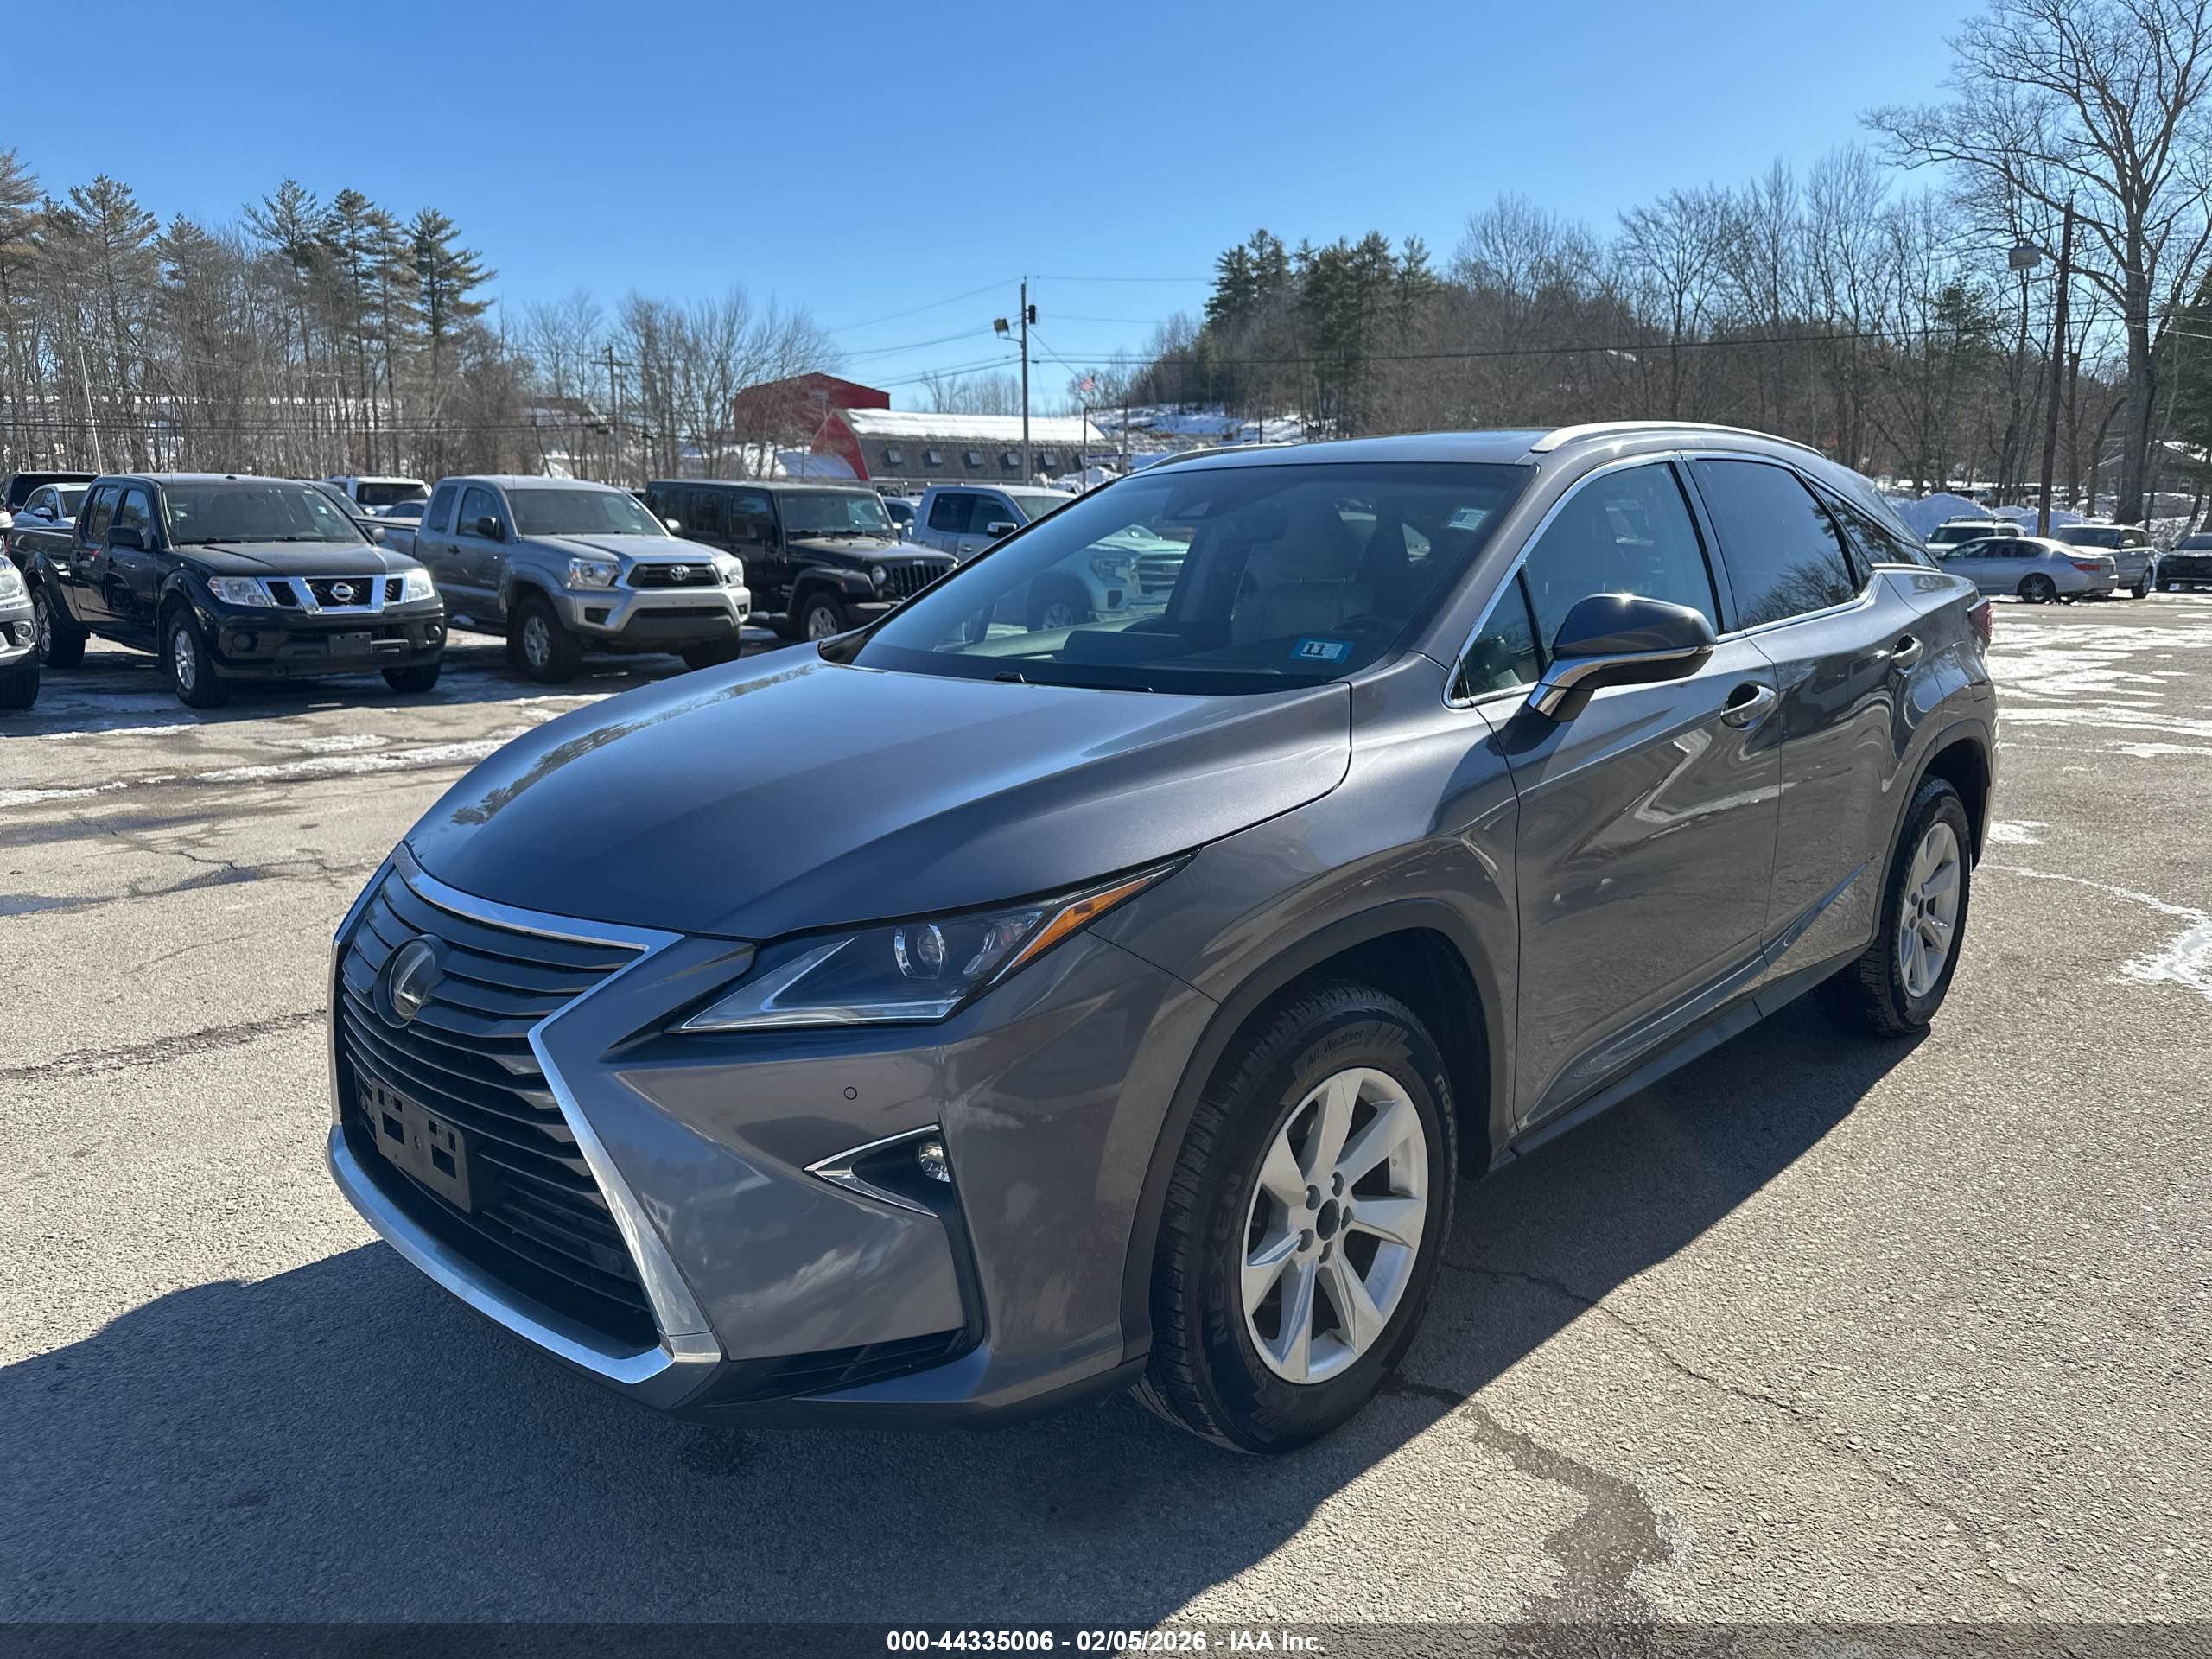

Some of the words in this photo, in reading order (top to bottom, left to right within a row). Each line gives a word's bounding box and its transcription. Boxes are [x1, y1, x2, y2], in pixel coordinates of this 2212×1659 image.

[1301, 643, 1325, 656] 11
[1306, 1028, 1364, 1069] All-Weather
[1209, 1172, 1243, 1347] NEXEN
